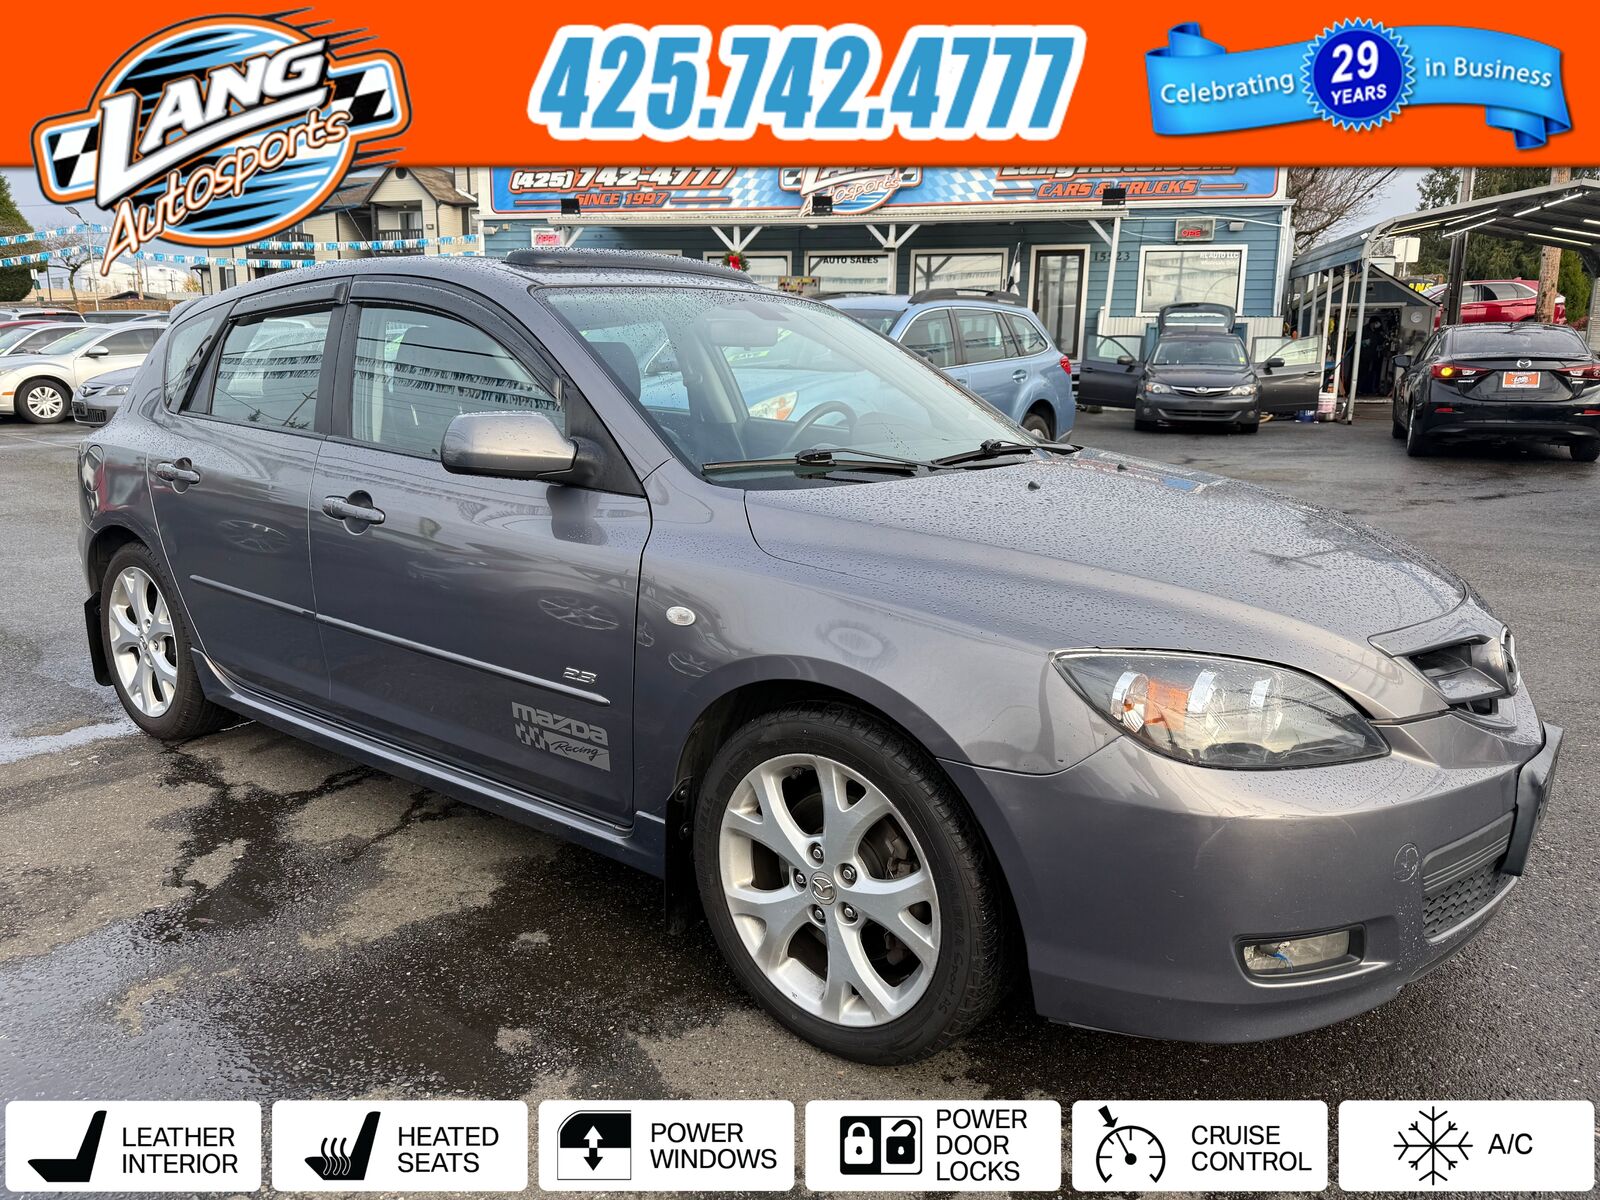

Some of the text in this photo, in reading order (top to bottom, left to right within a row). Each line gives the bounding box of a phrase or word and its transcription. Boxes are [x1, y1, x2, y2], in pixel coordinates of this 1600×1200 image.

[512, 171, 574, 190] (425)
[1037, 182, 1093, 197] CARS
[1117, 180, 1199, 195] TRUCKS
[575, 192, 668, 206] SINCE 1997
[850, 256, 879, 264] SALES
[550, 740, 605, 761] Racing
